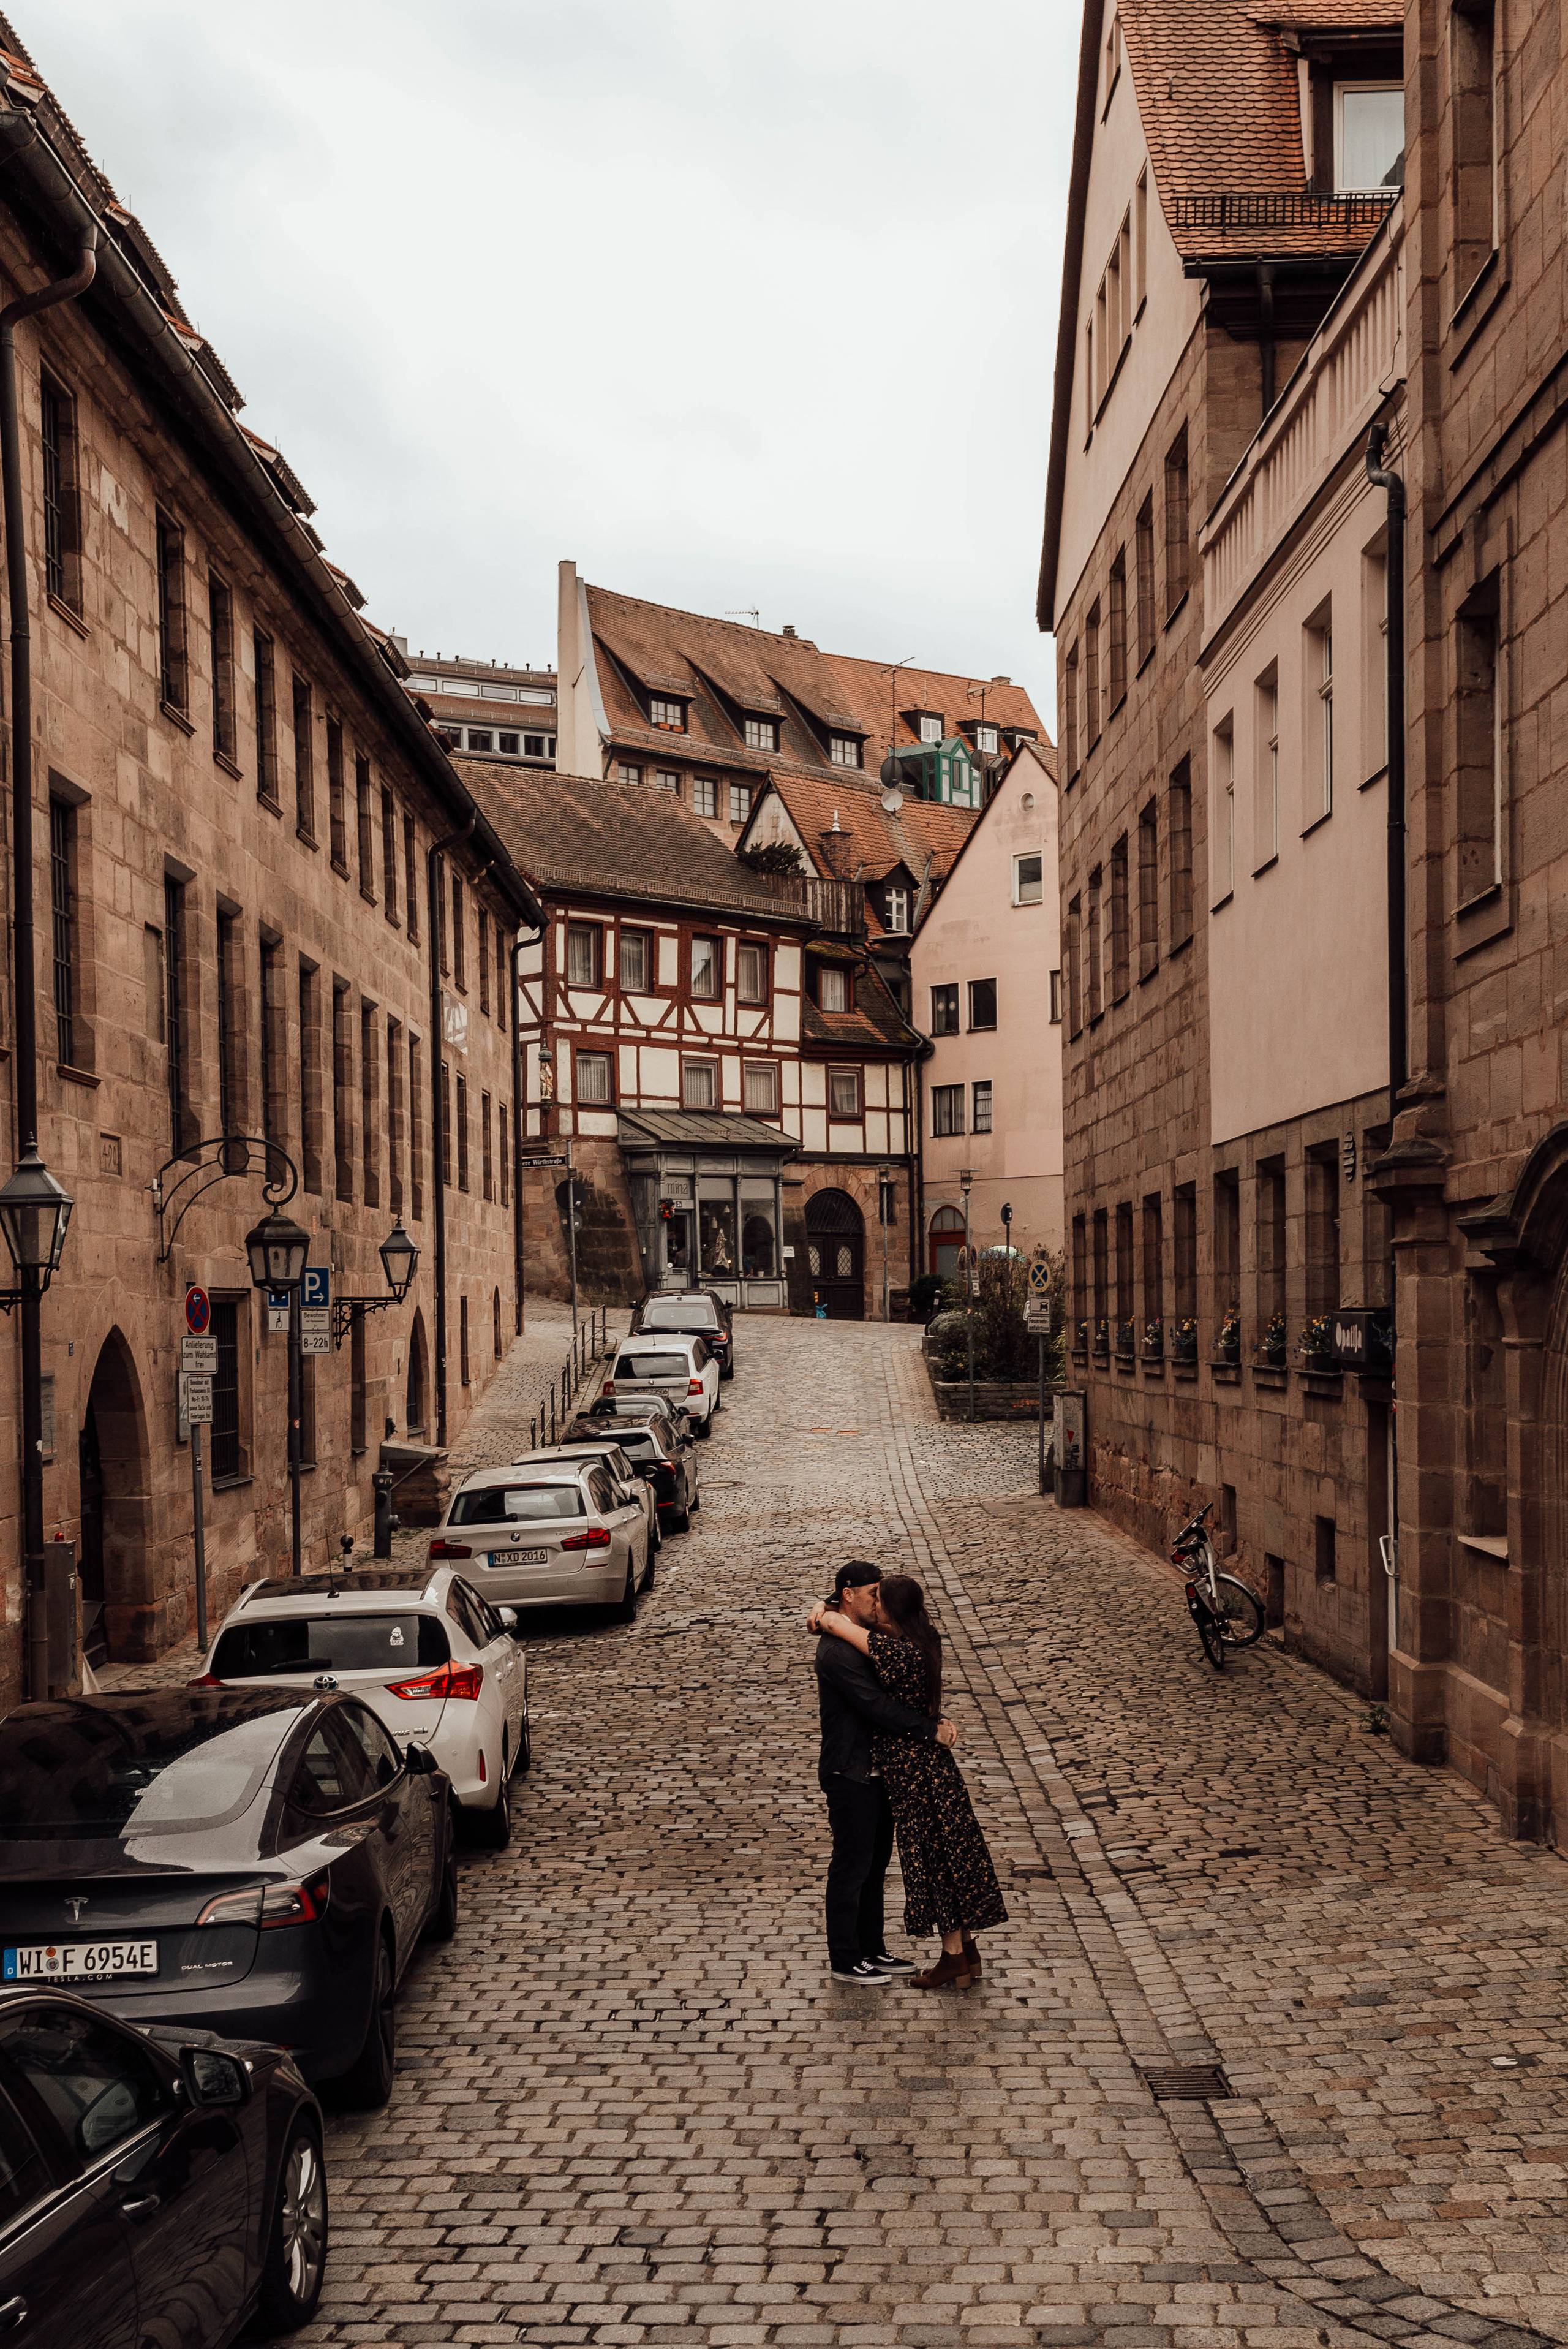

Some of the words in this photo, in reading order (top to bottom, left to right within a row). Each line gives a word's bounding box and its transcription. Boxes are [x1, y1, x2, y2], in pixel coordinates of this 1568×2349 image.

[667, 1180, 688, 1195] mina
[305, 1273, 320, 1302] P
[185, 1340, 214, 1351] Anlieferung
[304, 1337, 328, 1348] 8-22h
[195, 1360, 205, 1369] frei
[494, 1554, 500, 1563] N
[507, 1553, 519, 1562] XD
[522, 1551, 545, 1561] 2016
[20, 1951, 44, 1975] WI
[62, 1948, 76, 1973] F
[84, 1945, 153, 1971] 6954E
[47, 1974, 113, 1983] TESLA.COM
